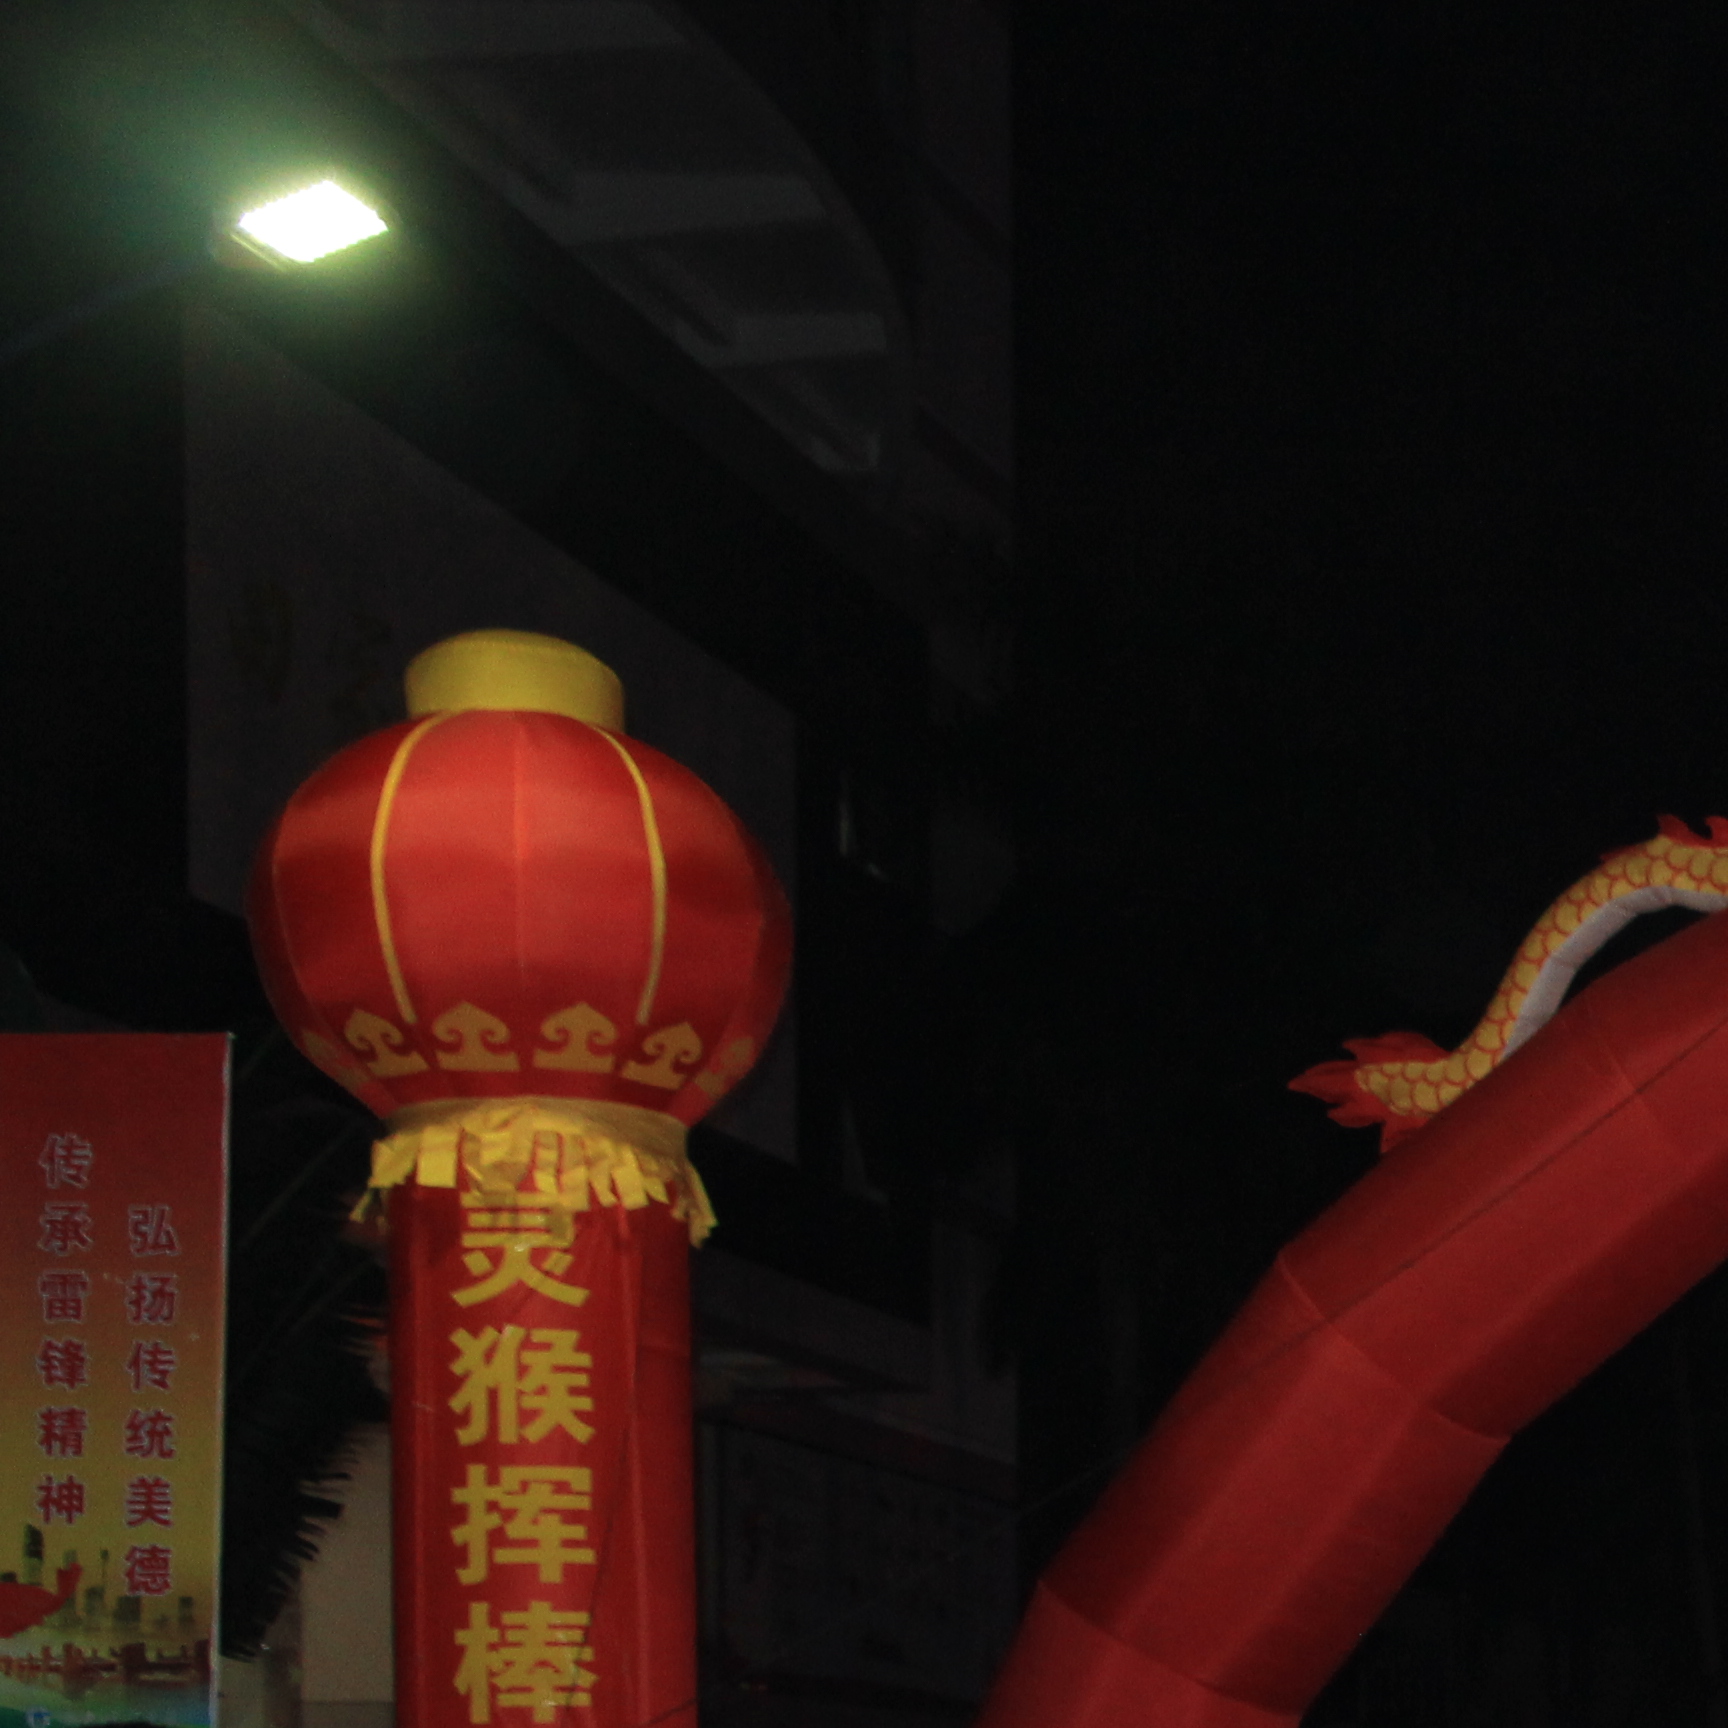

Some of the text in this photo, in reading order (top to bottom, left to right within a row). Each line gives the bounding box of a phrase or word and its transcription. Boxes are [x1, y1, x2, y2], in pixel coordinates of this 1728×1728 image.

[37, 1132, 94, 1527] 传承雷锋精神
[123, 1203, 180, 1600] 弘扬传统美德
